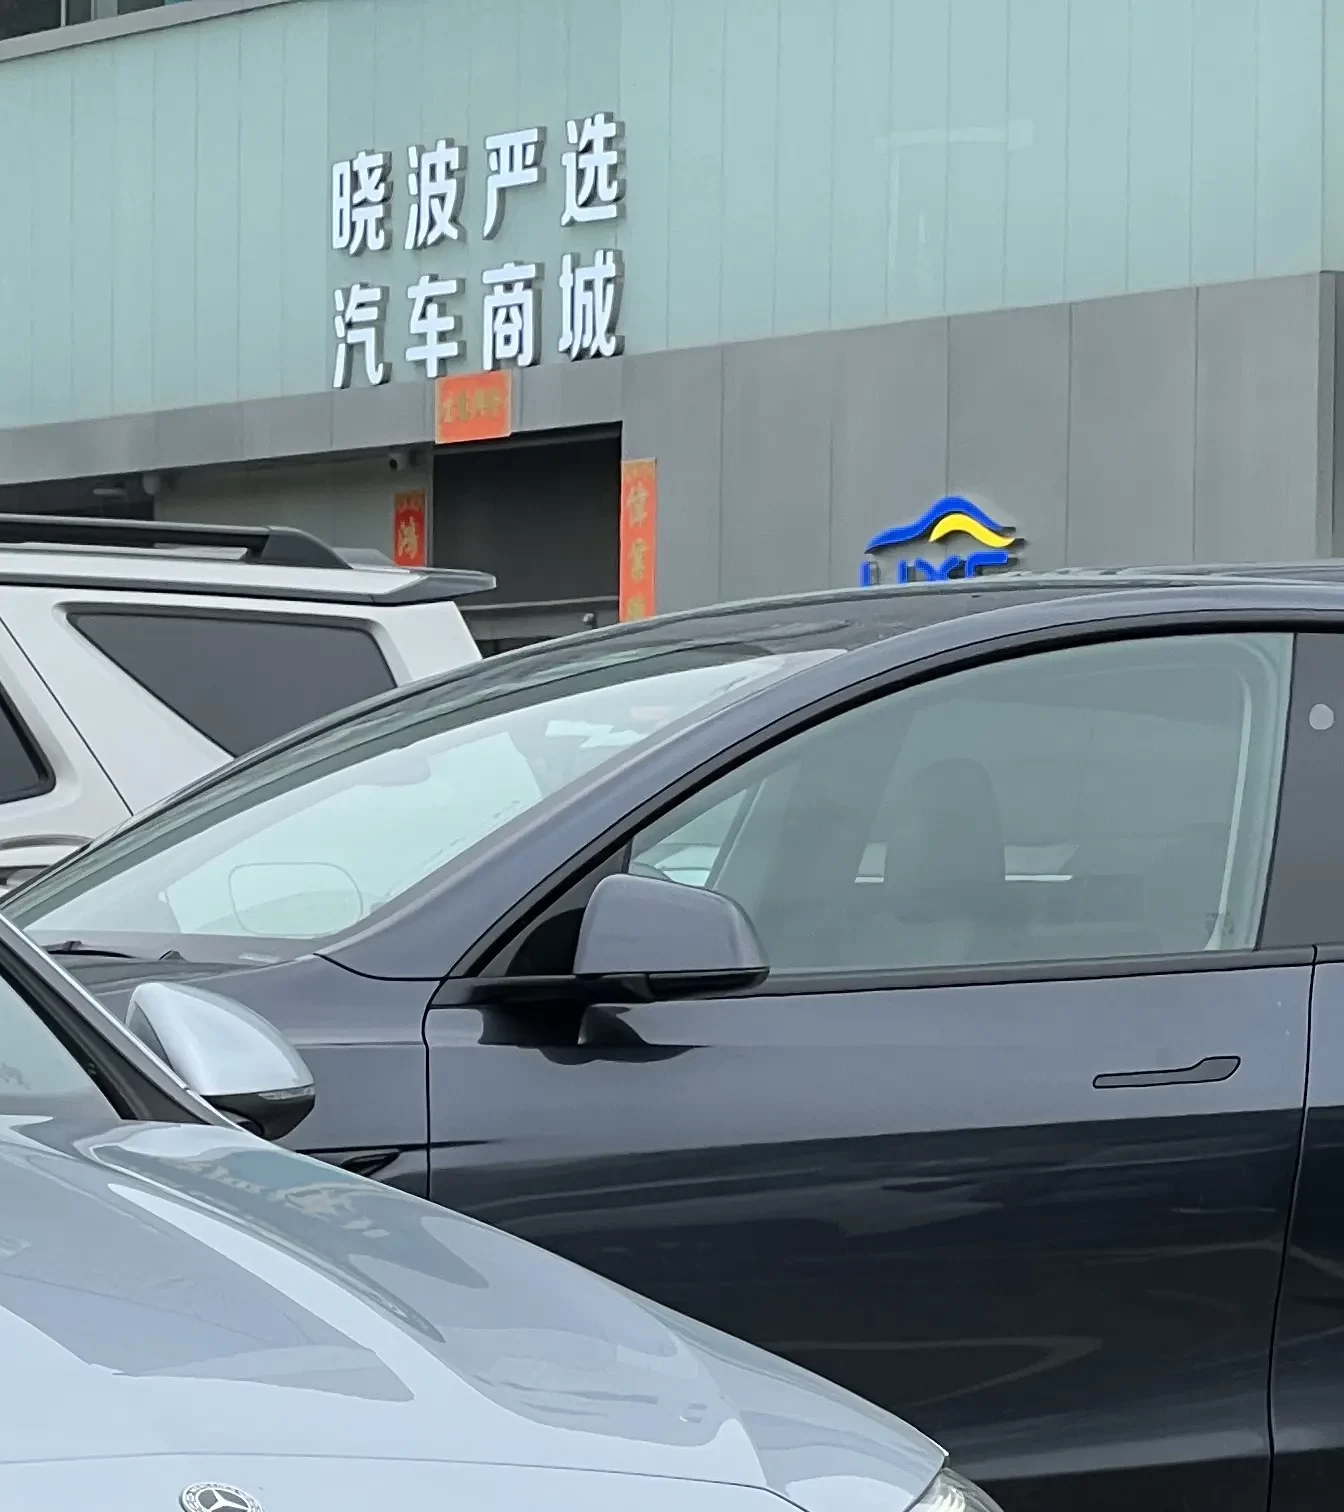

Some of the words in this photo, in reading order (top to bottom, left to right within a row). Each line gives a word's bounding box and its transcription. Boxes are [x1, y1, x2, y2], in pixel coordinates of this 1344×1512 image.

[331, 111, 619, 256] 晓波严选
[332, 248, 618, 389] 汽车商城
